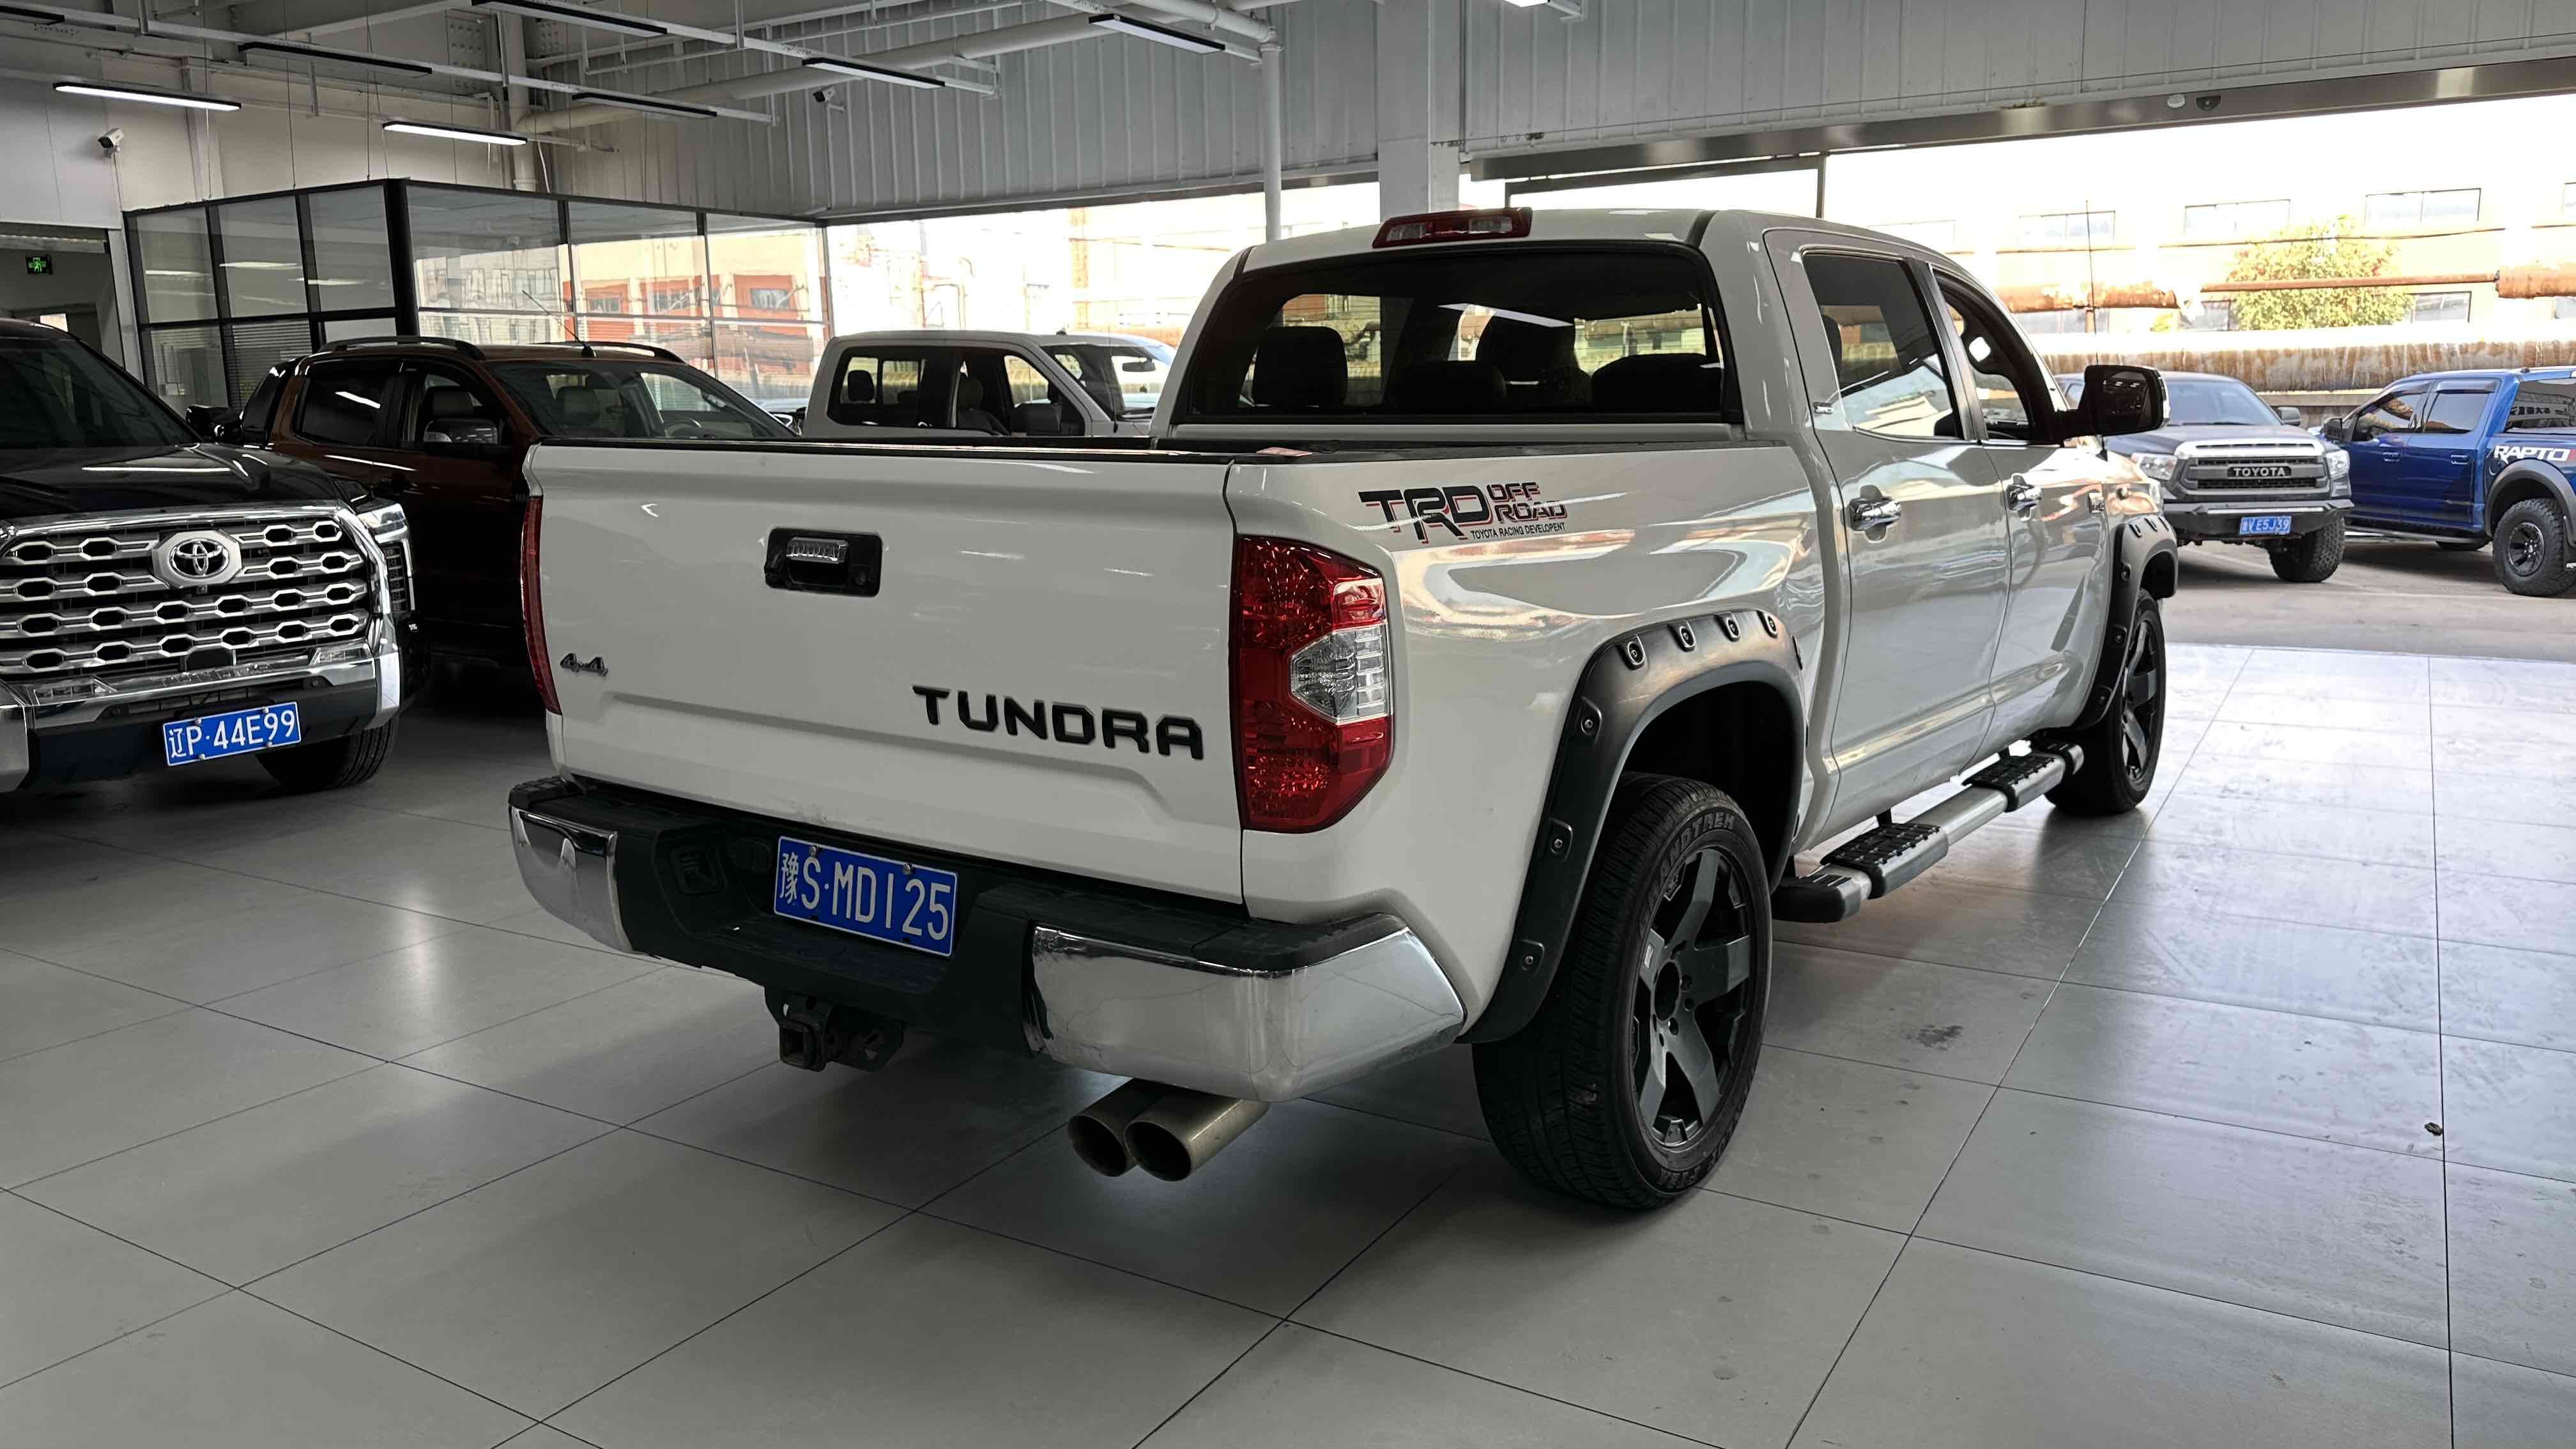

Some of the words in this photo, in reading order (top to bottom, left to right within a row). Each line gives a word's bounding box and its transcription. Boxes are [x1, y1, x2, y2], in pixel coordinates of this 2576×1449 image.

[2233, 467, 2285, 477] TOYOTA
[1487, 482, 1540, 502] OFF
[1358, 486, 1494, 544] TRD
[1494, 500, 1567, 523] ROAD
[1471, 528, 1498, 540] TOYOTA
[1499, 525, 1524, 537] RACING
[169, 710, 295, 758] 辽P·44E99
[911, 685, 1204, 760] TUNDRA
